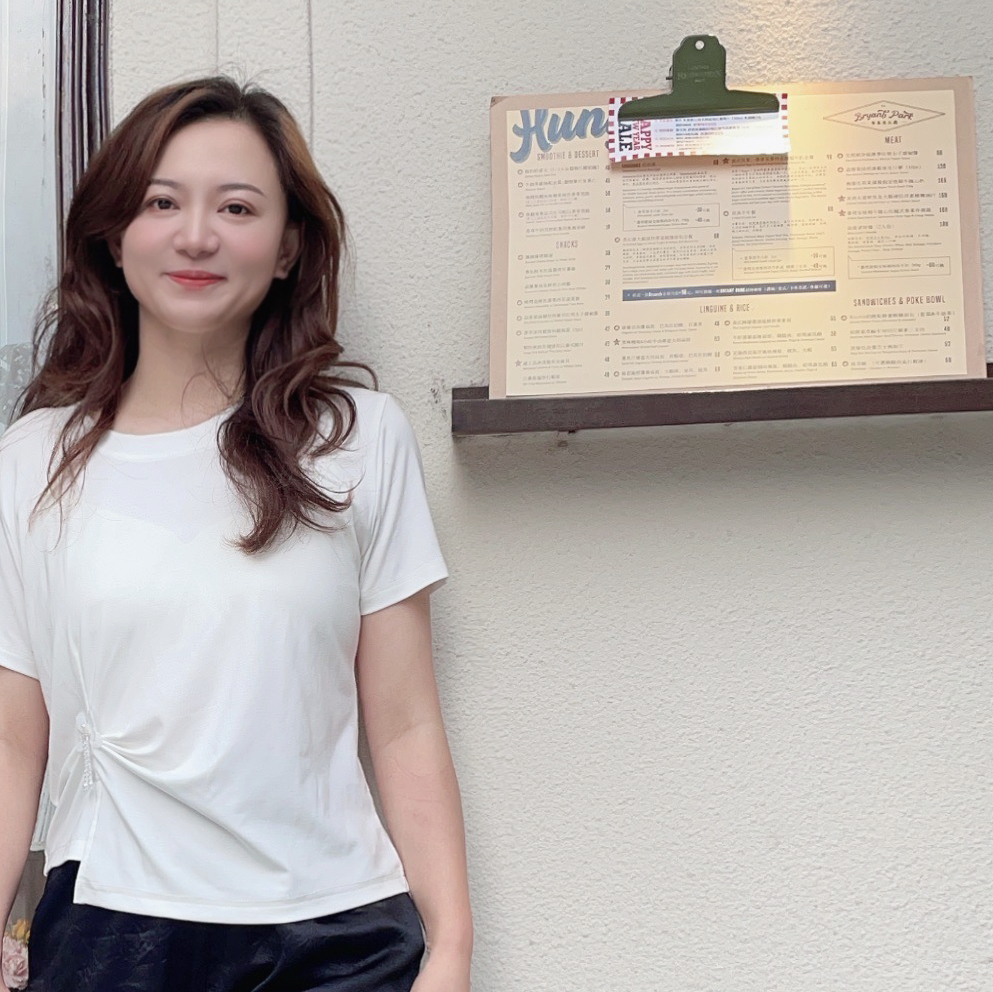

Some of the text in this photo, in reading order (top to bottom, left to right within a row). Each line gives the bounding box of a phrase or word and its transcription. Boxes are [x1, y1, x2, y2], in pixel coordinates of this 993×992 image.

[618, 120, 633, 152] ALE
[640, 120, 653, 151] APPY
[884, 136, 902, 144] MEAT
[537, 151, 566, 161] SMOOTHIE
[574, 150, 600, 159] DESSERT
[555, 240, 578, 249] SNACKS
[853, 297, 896, 307] SANDWICHES
[906, 296, 924, 305] POKE
[925, 295, 946, 304] BOWL
[699, 304, 728, 314] LINGUINE
[736, 303, 750, 312] RICE
